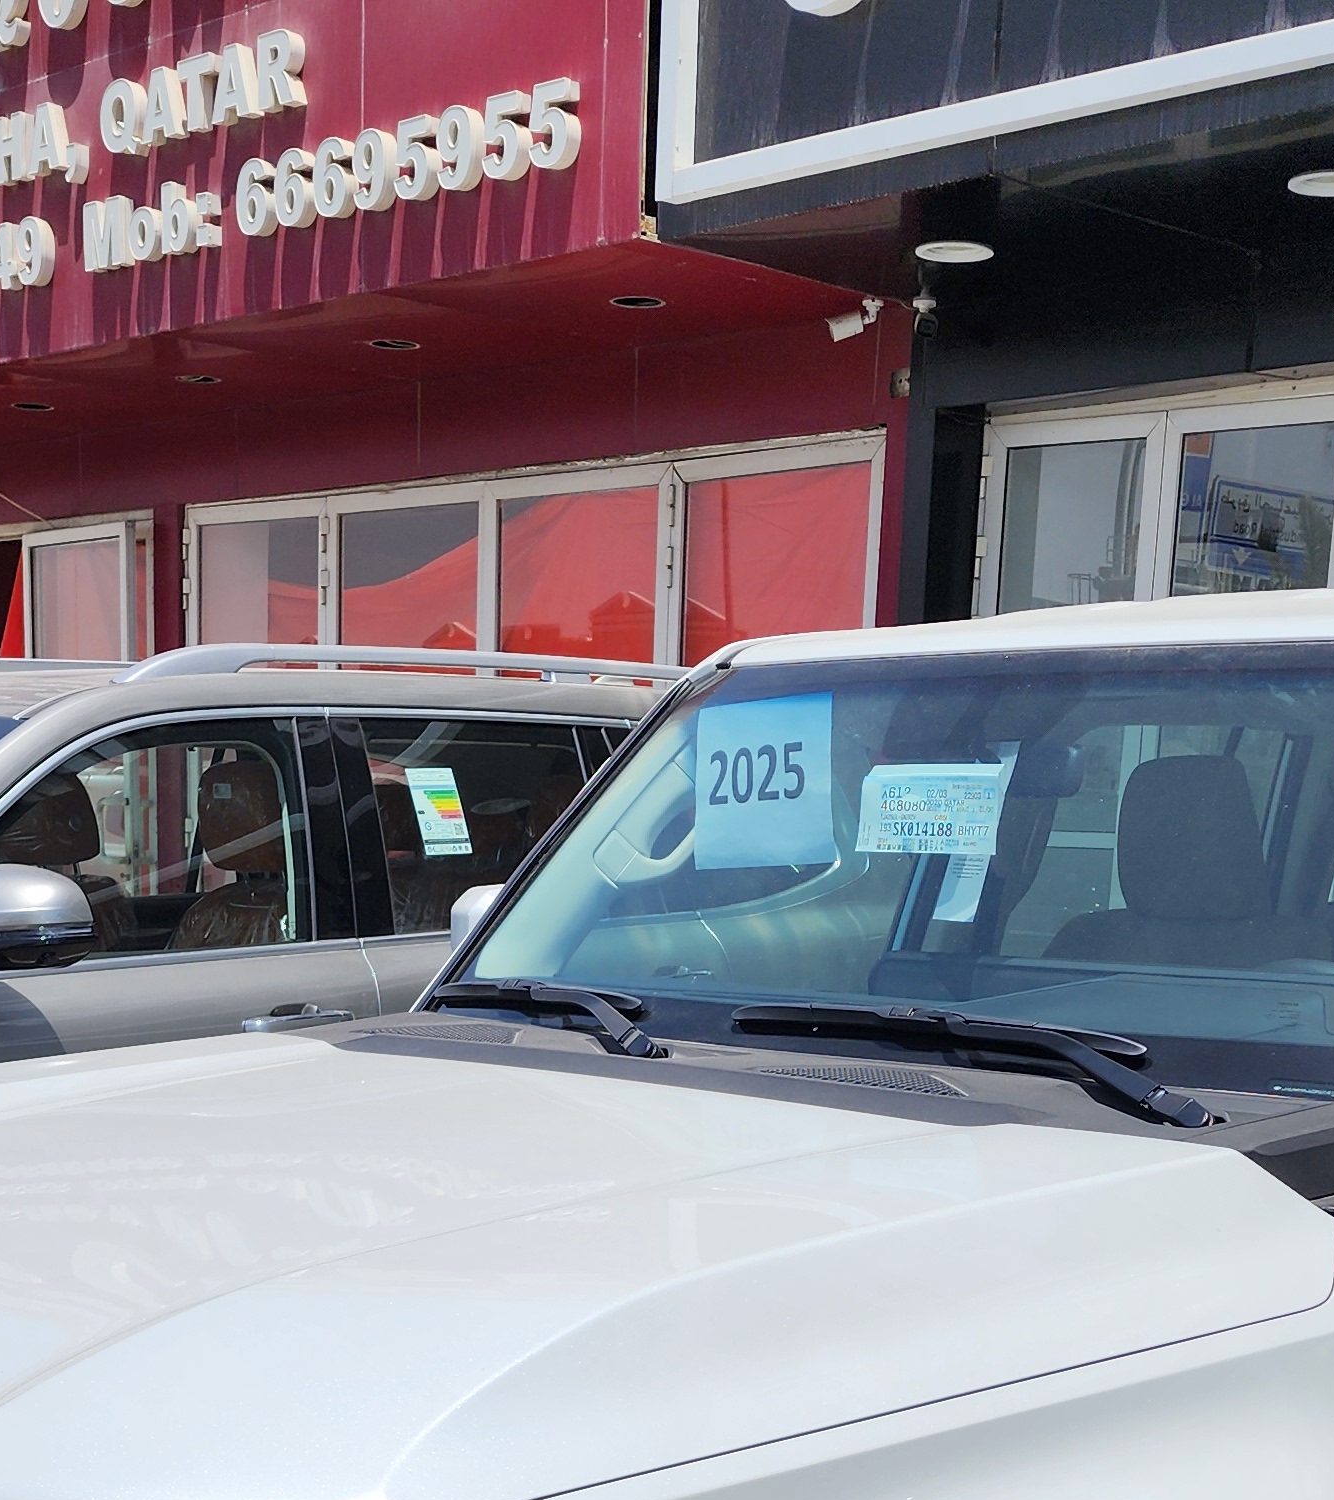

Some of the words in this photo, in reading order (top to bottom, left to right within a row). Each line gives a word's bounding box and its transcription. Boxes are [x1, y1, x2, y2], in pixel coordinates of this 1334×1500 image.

[100, 28, 308, 158] QATAR
[83, 181, 222, 273] Mob:
[235, 76, 581, 237] 66695955
[709, 741, 806, 806] 2025
[892, 821, 953, 837] SK014188
